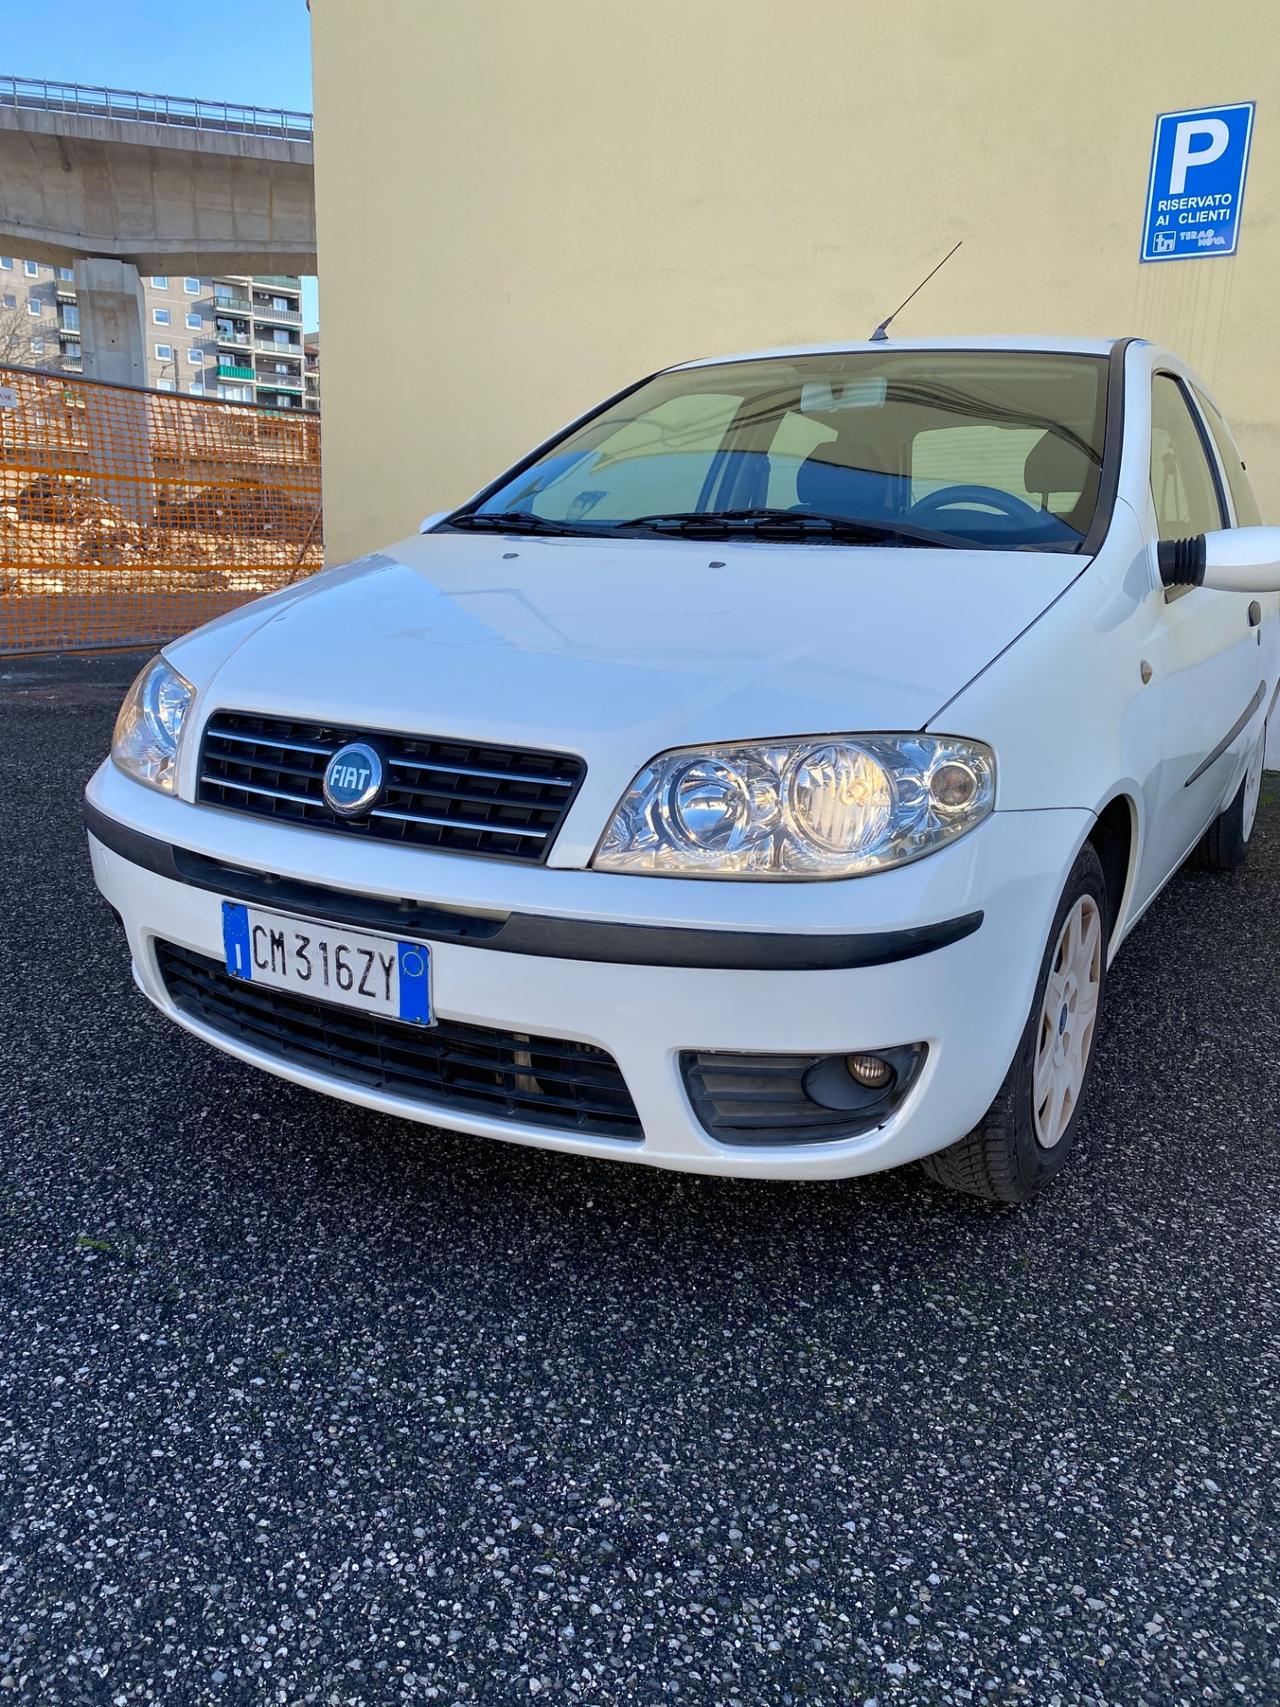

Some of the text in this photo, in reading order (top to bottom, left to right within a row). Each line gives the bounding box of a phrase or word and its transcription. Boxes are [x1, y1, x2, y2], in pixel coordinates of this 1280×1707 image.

[1169, 118, 1230, 195] P
[1158, 194, 1232, 212] RISERVATO
[1156, 209, 1230, 227] AI CLIENTI
[1180, 229, 1214, 240] TERMO
[1198, 236, 1225, 247] NOVA
[330, 765, 370, 790] FIAT
